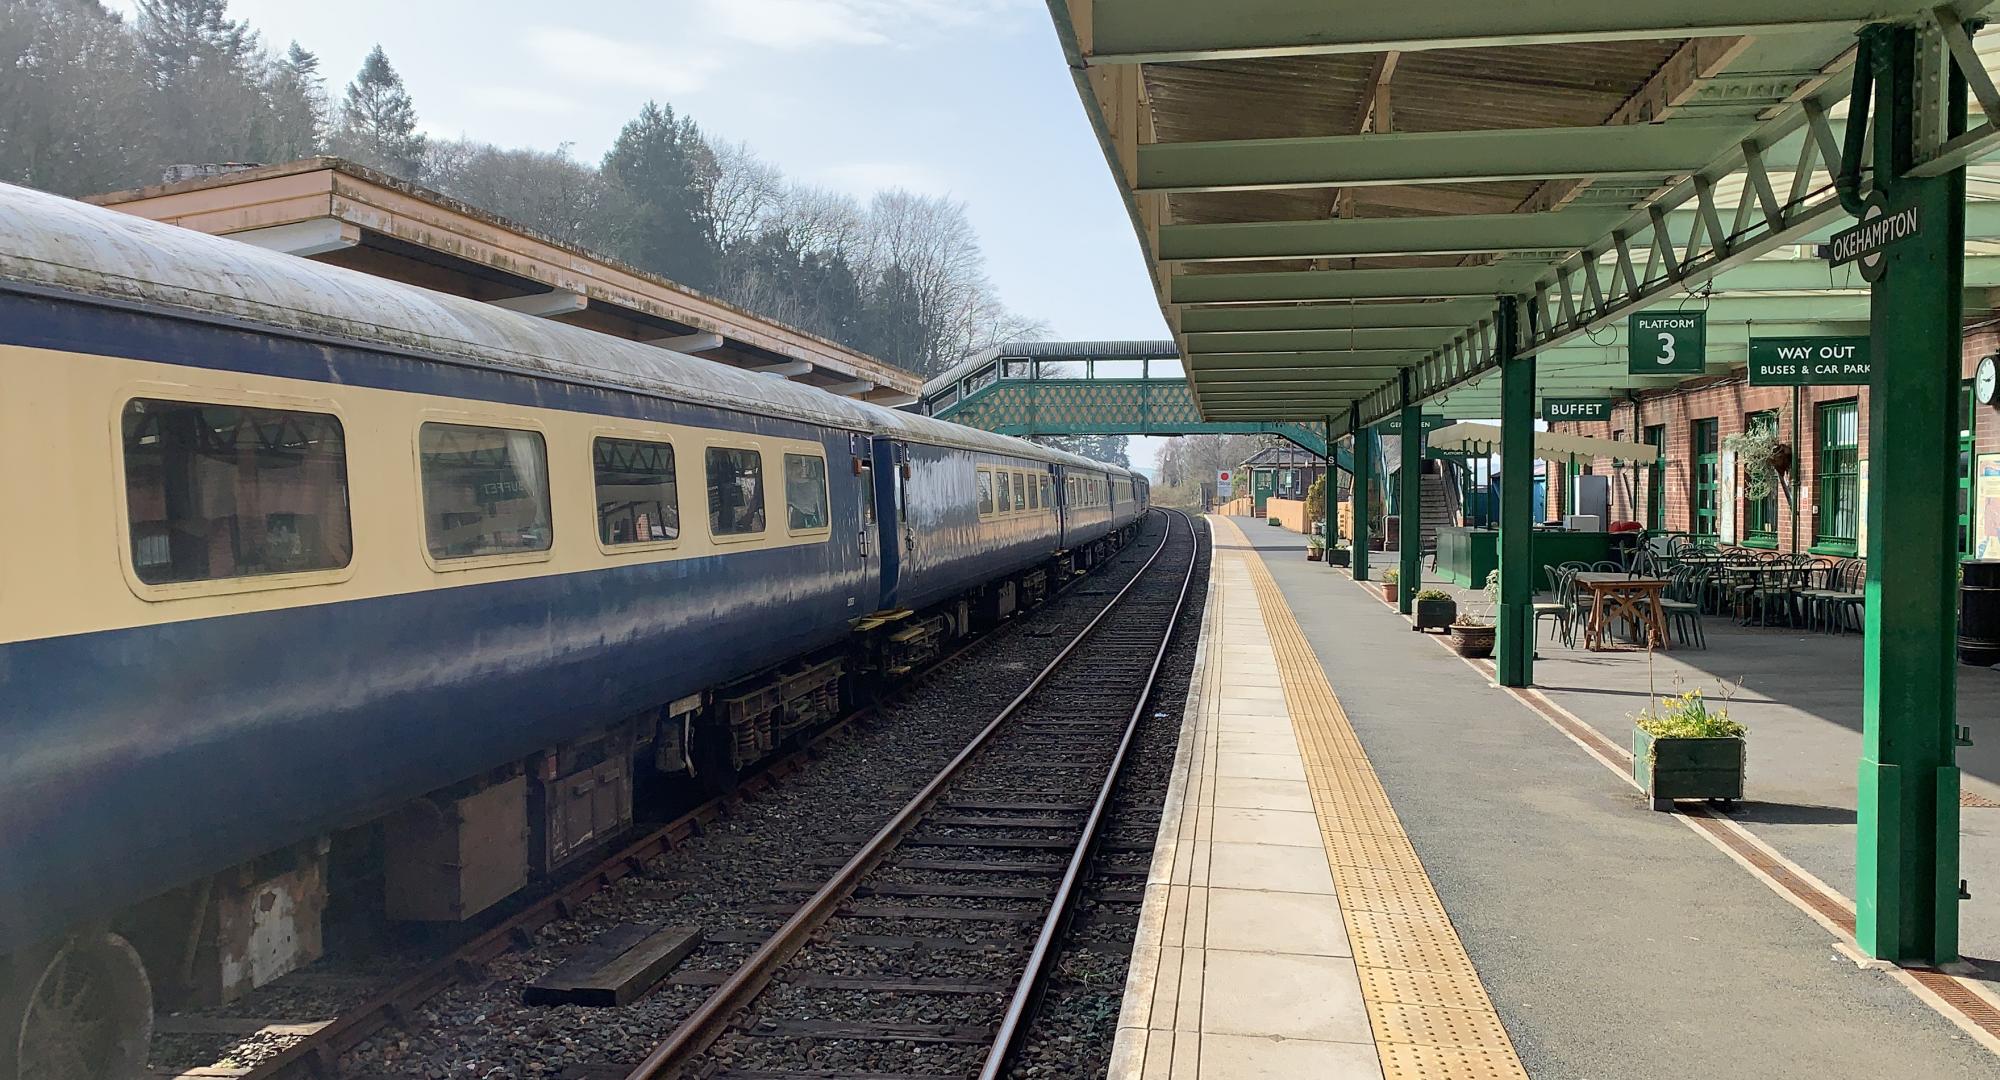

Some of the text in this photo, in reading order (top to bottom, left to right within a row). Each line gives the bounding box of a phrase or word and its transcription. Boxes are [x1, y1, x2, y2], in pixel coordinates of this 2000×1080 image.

[1834, 207, 1917, 261] OKEHAMPTON
[1639, 319, 1694, 328] PLATFORM
[1656, 333, 1676, 364] 3
[1777, 346, 1855, 359] WAY OUT
[1760, 364, 1870, 375] BUSES & CAR PARK
[1551, 404, 1602, 415] BUFFET
[1328, 456, 1335, 464] S
